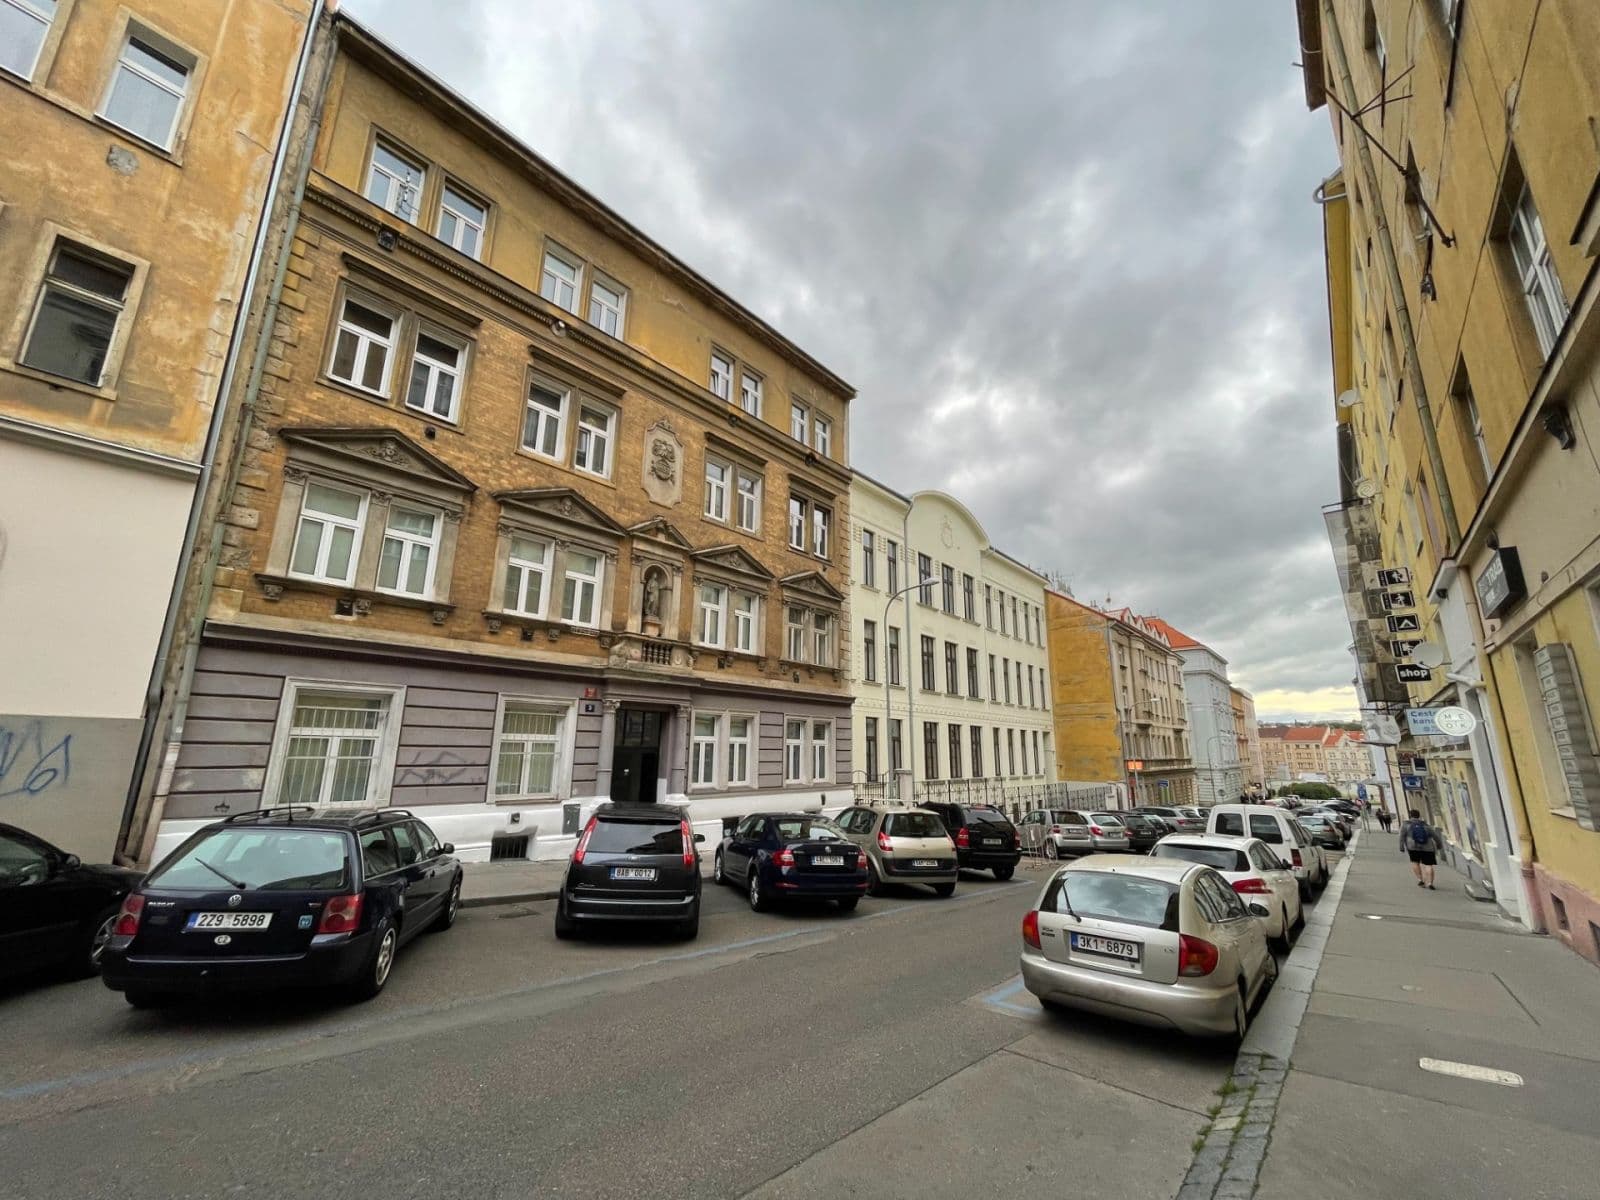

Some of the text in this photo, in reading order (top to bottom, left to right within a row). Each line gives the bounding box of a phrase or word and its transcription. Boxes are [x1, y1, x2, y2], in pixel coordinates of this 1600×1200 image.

[1400, 668, 1428, 679] shop
[197, 914, 267, 927] 2Z9 5898
[1079, 936, 1134, 956] 3K1 6879
